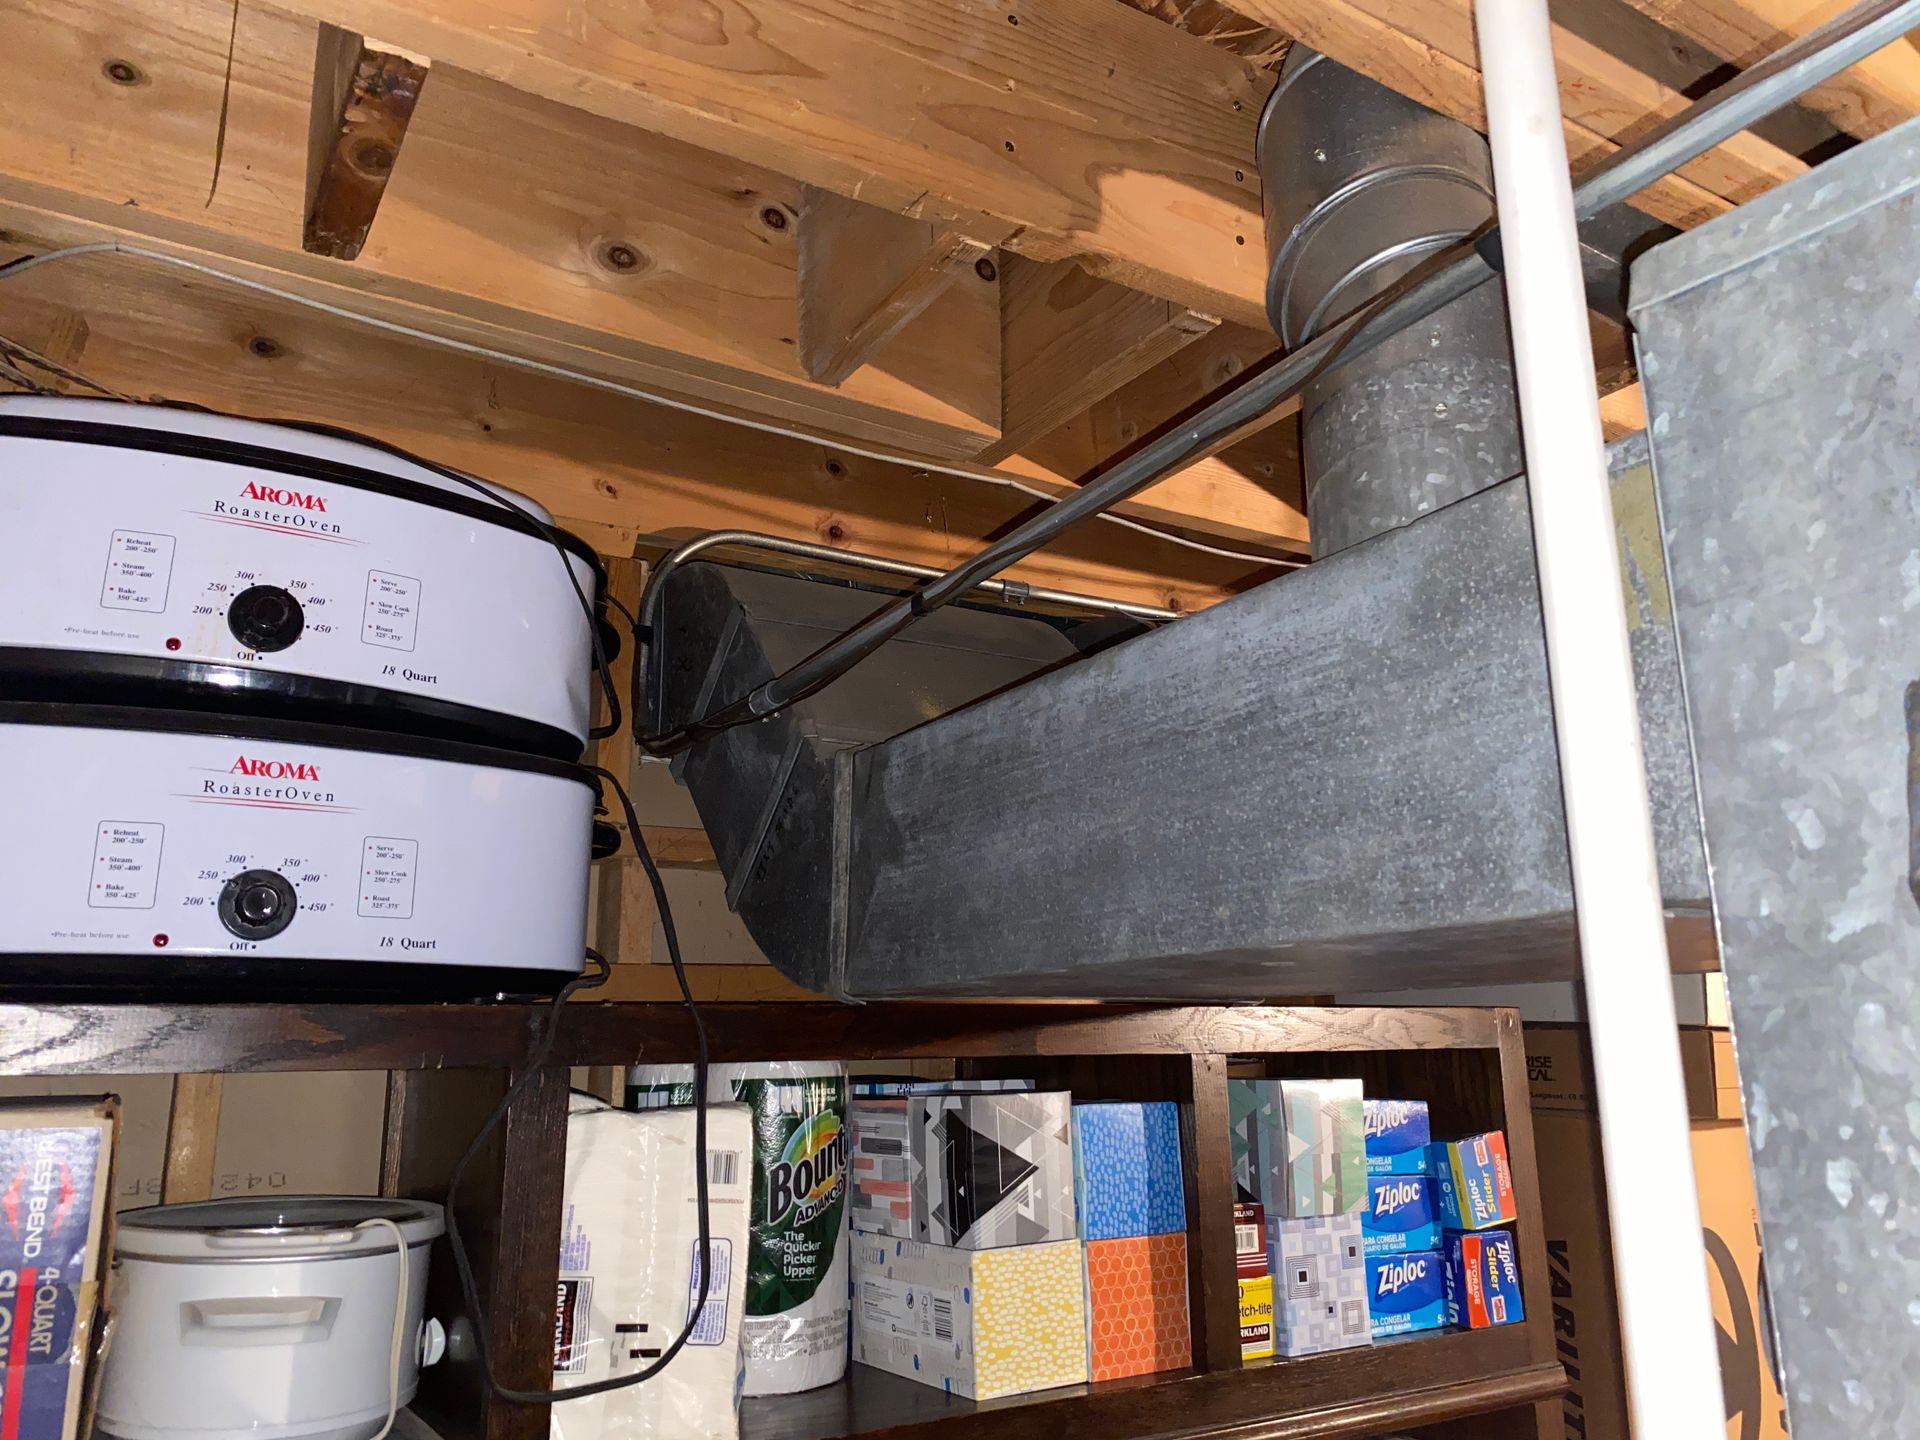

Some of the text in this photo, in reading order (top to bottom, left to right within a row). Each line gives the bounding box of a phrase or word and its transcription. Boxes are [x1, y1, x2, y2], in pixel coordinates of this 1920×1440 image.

[240, 481, 326, 512] AROMA
[214, 500, 341, 533] RoasterOven
[126, 538, 152, 547] Reheat
[122, 562, 145, 570] Steam
[118, 586, 137, 595] Bake
[380, 578, 397, 588] Serve
[378, 601, 410, 613] Slow Cook
[101, 629, 125, 638] before
[376, 624, 393, 633] Roast
[237, 651, 256, 661] Off
[382, 664, 438, 684] 18 Quart
[229, 755, 318, 781] AROMA
[203, 780, 334, 802] RoasterOven
[105, 883, 125, 891] Bake
[230, 942, 250, 951] Off
[380, 936, 437, 950] 18 Quart
[1364, 1101, 1409, 1137] Ziploc
[1375, 1181, 1420, 1215] Ziploc
[1469, 1178, 1489, 1221] Ziploc
[1482, 1170, 1496, 1213] Slider
[24, 1195, 48, 1259] BEND
[784, 1231, 805, 1241] The
[784, 1254, 816, 1265] Picker
[1486, 1246, 1499, 1290] Slider
[1495, 1240, 1515, 1284] Ziploc
[784, 1265, 816, 1278] Upper
[1378, 1259, 1426, 1294] Ziploc
[1470, 1258, 1480, 1305] STORAGE
[29, 1266, 60, 1355] 4-QUART
